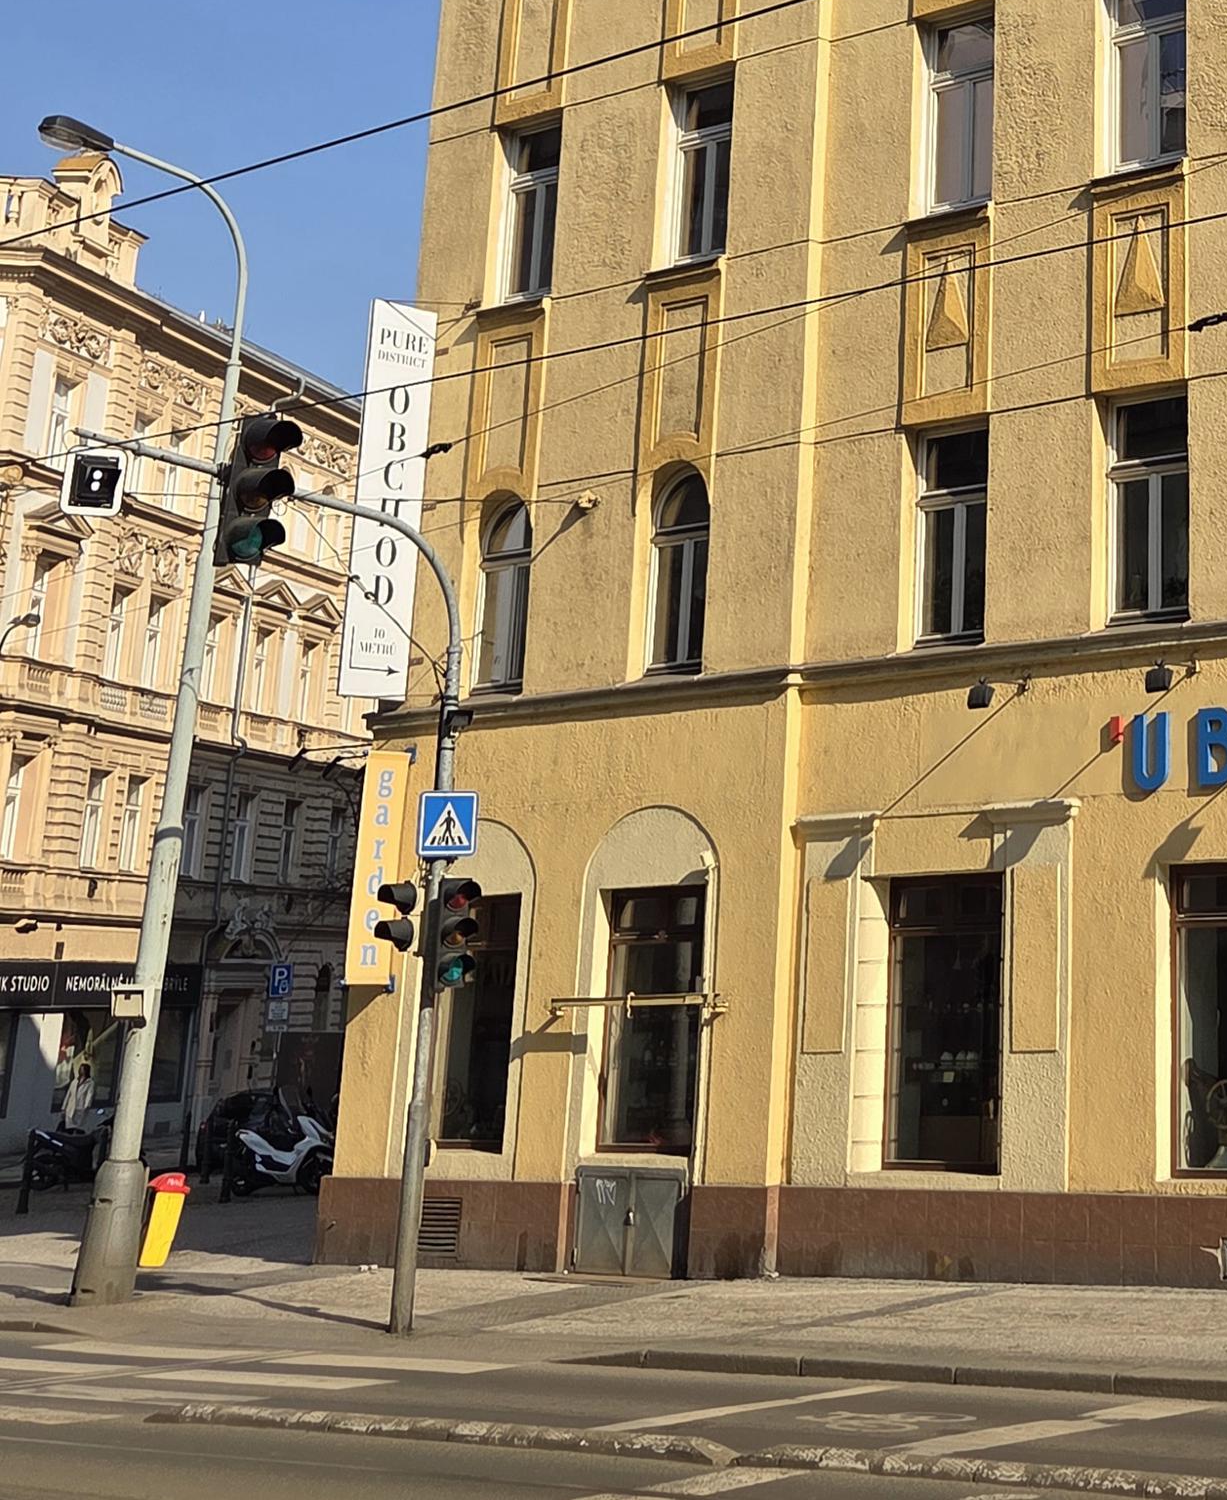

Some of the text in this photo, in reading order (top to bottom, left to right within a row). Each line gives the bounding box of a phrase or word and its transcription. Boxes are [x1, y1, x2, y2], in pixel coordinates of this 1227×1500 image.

[379, 327, 430, 355] PURE
[377, 348, 428, 369] DISTRICT
[1132, 711, 1170, 791] U
[360, 769, 395, 967] garden
[10, 975, 50, 992] STUDIO
[274, 967, 288, 987] P
